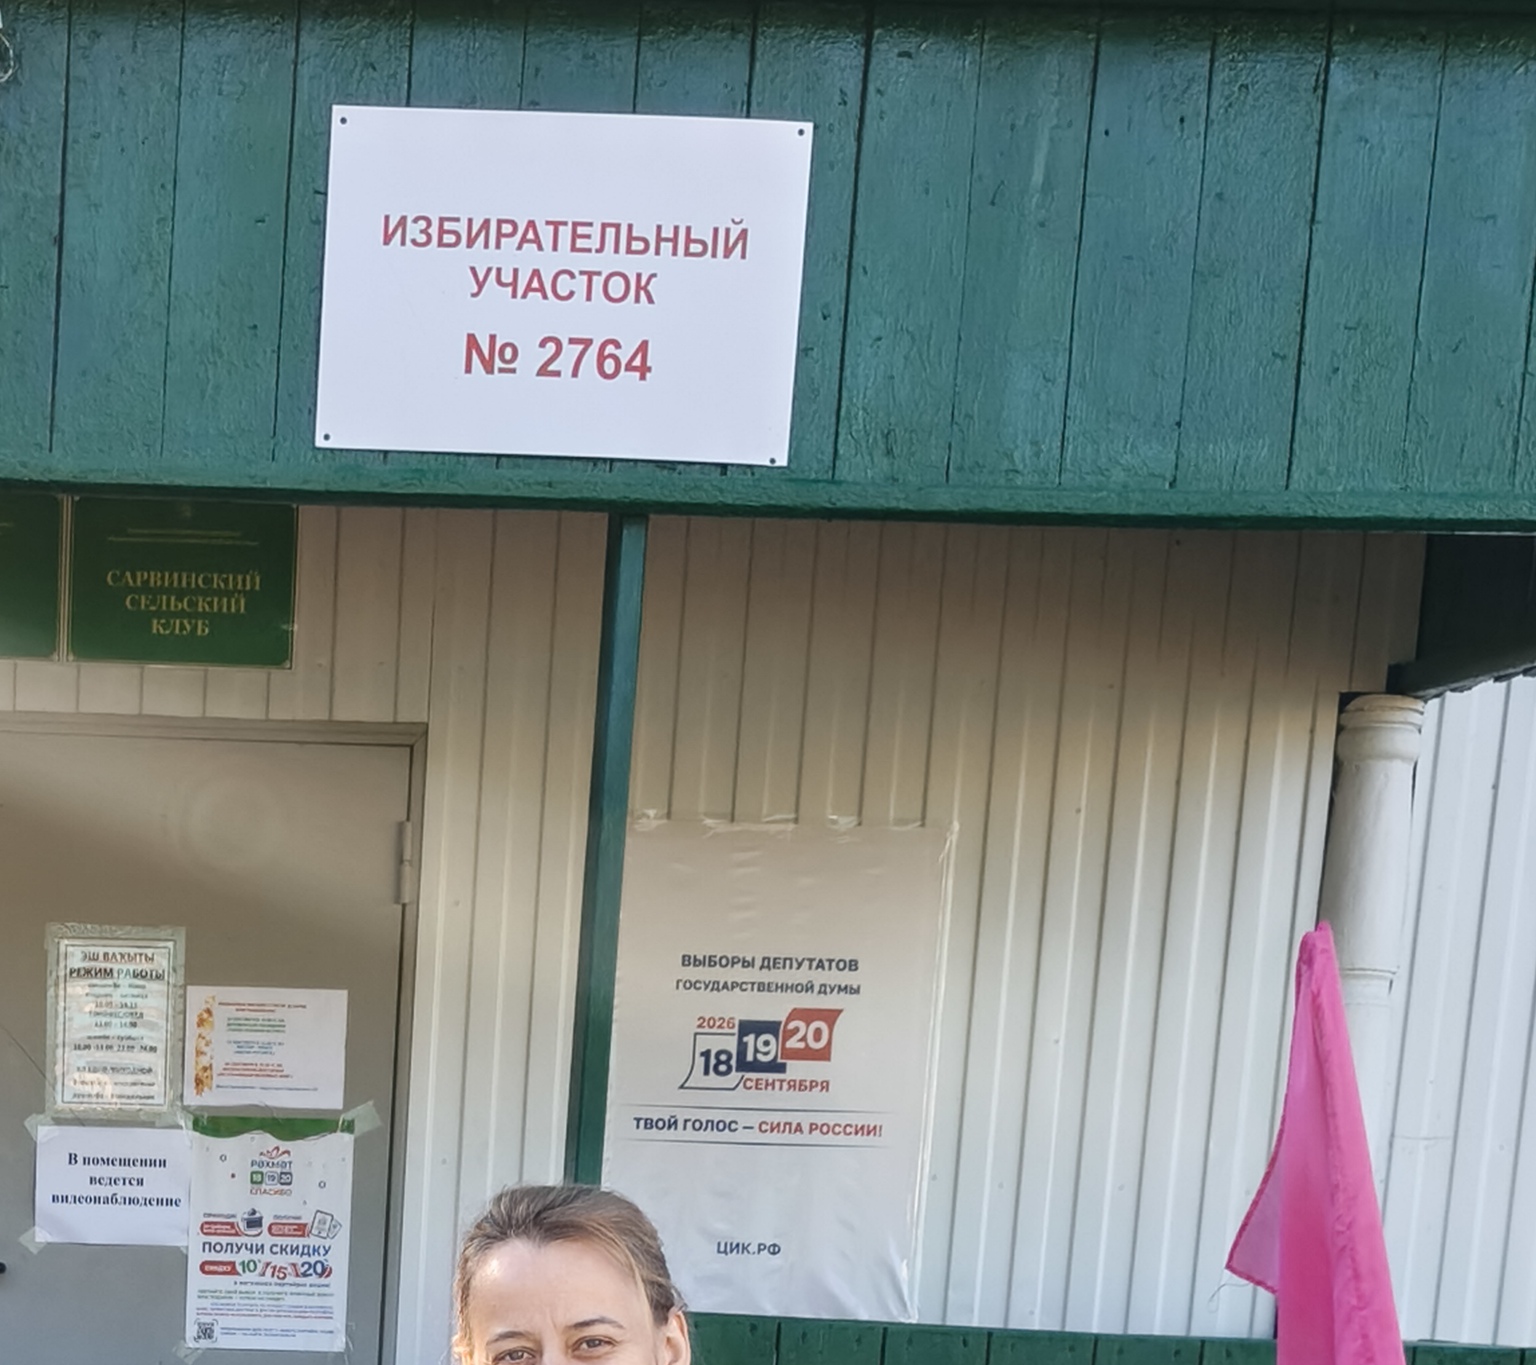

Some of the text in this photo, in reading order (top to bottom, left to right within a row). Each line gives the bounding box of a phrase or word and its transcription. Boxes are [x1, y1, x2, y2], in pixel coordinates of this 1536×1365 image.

[382, 213, 750, 260] ИЗБИРАТЕЛЬНЫЙ
[469, 266, 658, 304] УЧАСТОК
[464, 332, 653, 381] № 2764
[106, 569, 261, 591] САРВИНСКИЙ
[125, 592, 247, 614] СЕЛЬСКИЙ
[151, 618, 210, 637] КЛУБ
[681, 954, 860, 972] ВЫБОРЫ ДЕПУТАТОВ
[69, 966, 166, 981] РЕЖИМ РАБОТЫ
[675, 979, 861, 996] ГОСУДАРСТВЕННОЙ ДУМЫ
[696, 1016, 736, 1030] 2026
[785, 1019, 830, 1050] 20
[742, 1033, 778, 1063] 19
[699, 1048, 734, 1077] 18
[742, 1077, 830, 1093] СЕНТЯБРЯ
[633, 1115, 679, 1132] ТВОЙ
[682, 1117, 739, 1133] ГОЛОС
[758, 1121, 803, 1135] СИЛА
[808, 1122, 883, 1137] РОССИИ!
[67, 1152, 167, 1169] В помещении
[89, 1175, 145, 1188] ведется
[51, 1193, 182, 1208] видеонаблюдение
[250, 1187, 292, 1197] СПАСИБО
[202, 1241, 331, 1258] ПОЛУЧИ СКИДКУ
[716, 1241, 781, 1256] ЦИК.РФ
